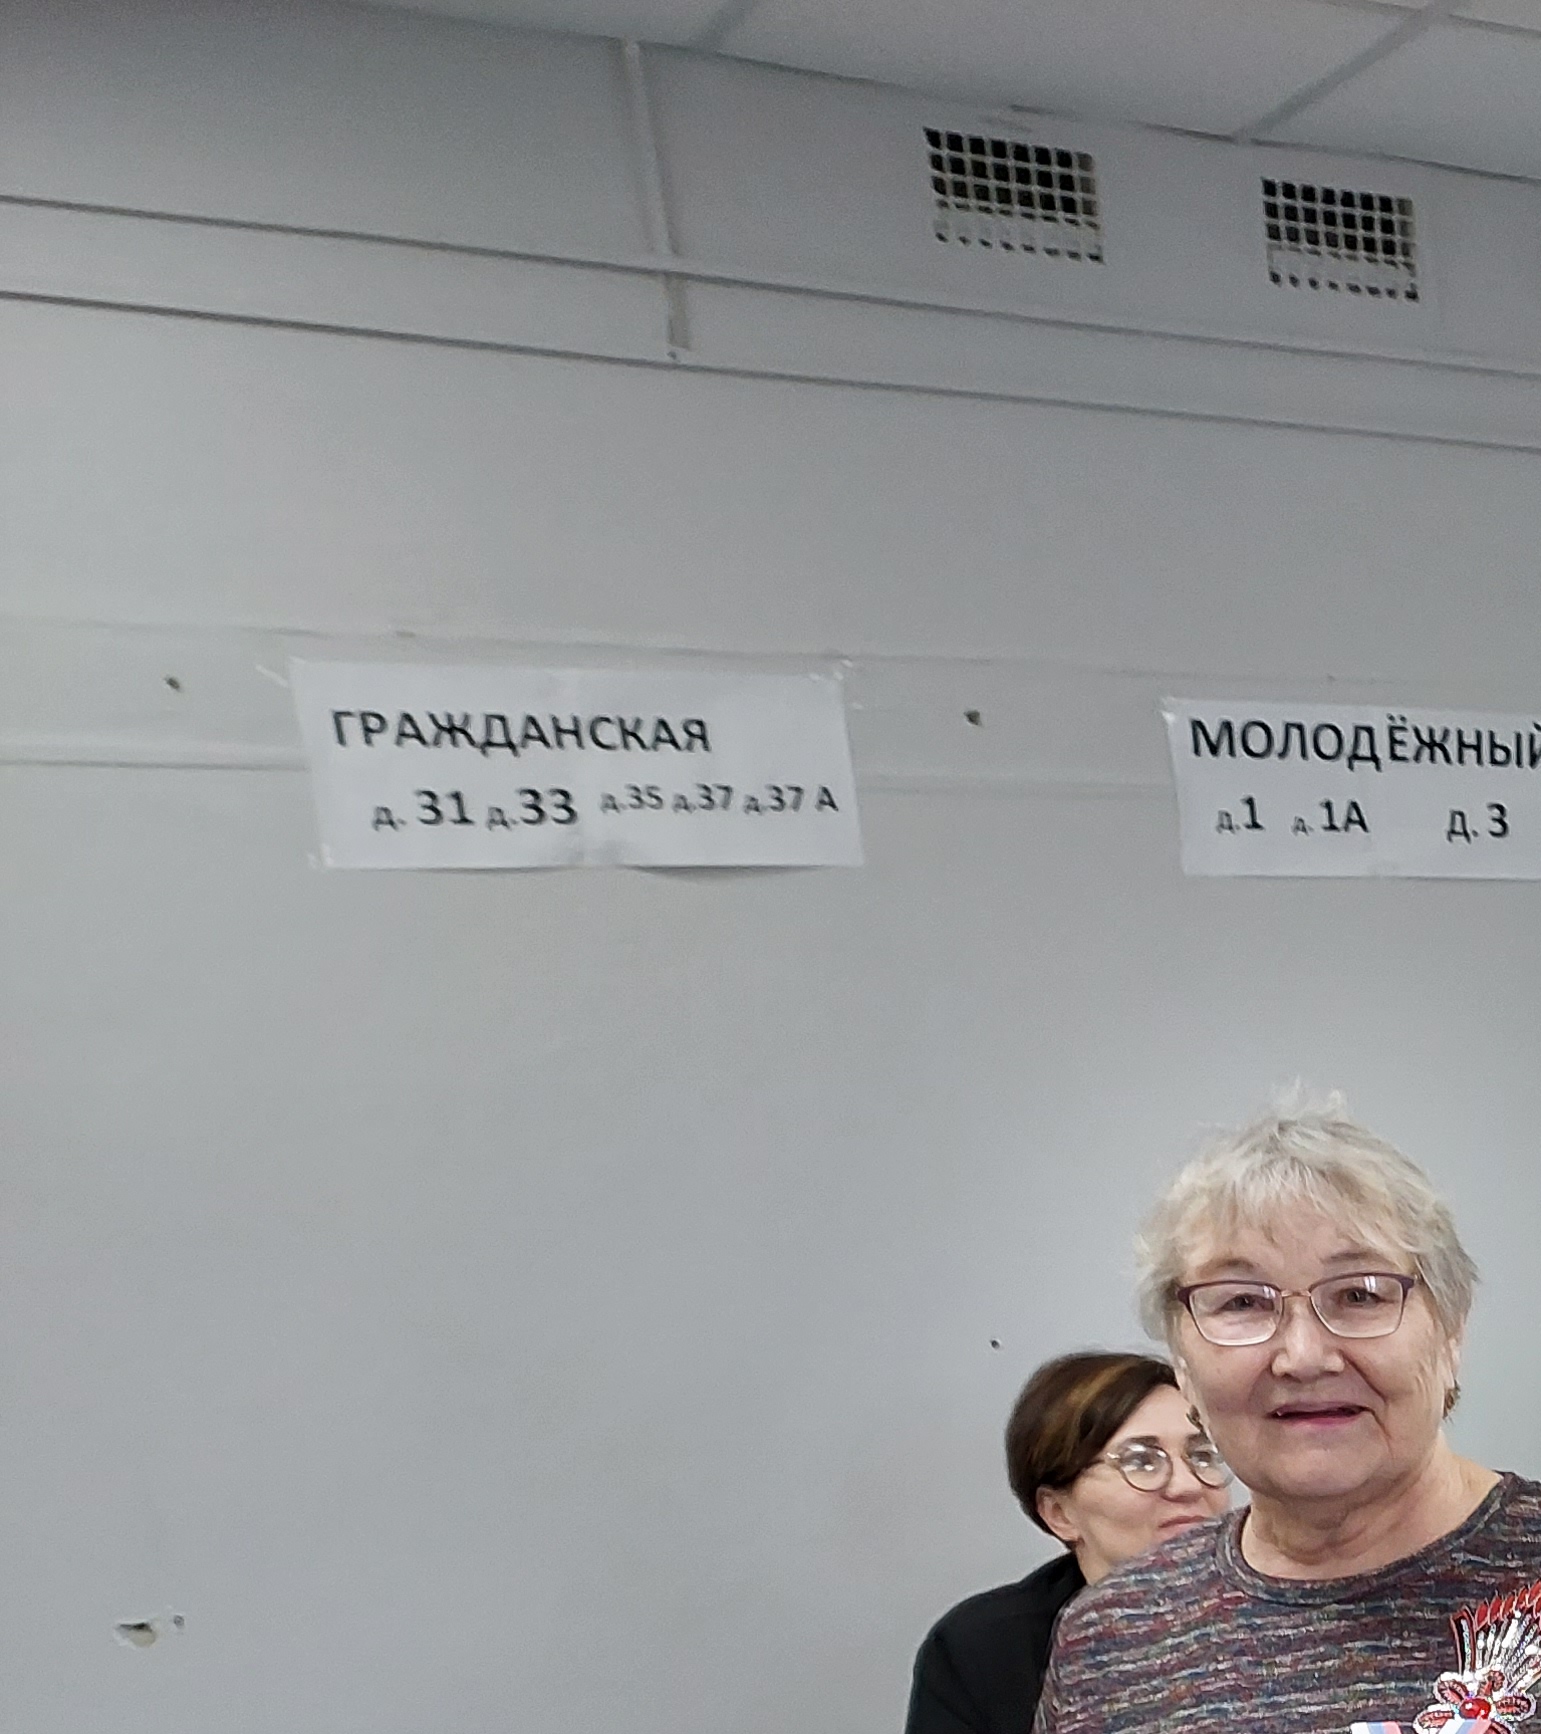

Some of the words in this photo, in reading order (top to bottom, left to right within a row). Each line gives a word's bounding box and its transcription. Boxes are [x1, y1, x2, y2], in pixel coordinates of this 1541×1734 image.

[331, 709, 713, 758] ГРАЖДАНСКАЯ
[414, 789, 476, 827] 31
[599, 783, 665, 815] д.35
[671, 782, 735, 815] д.37
[814, 784, 840, 813] А
[1215, 795, 1266, 836] д.1
[1486, 802, 1510, 840] 3
